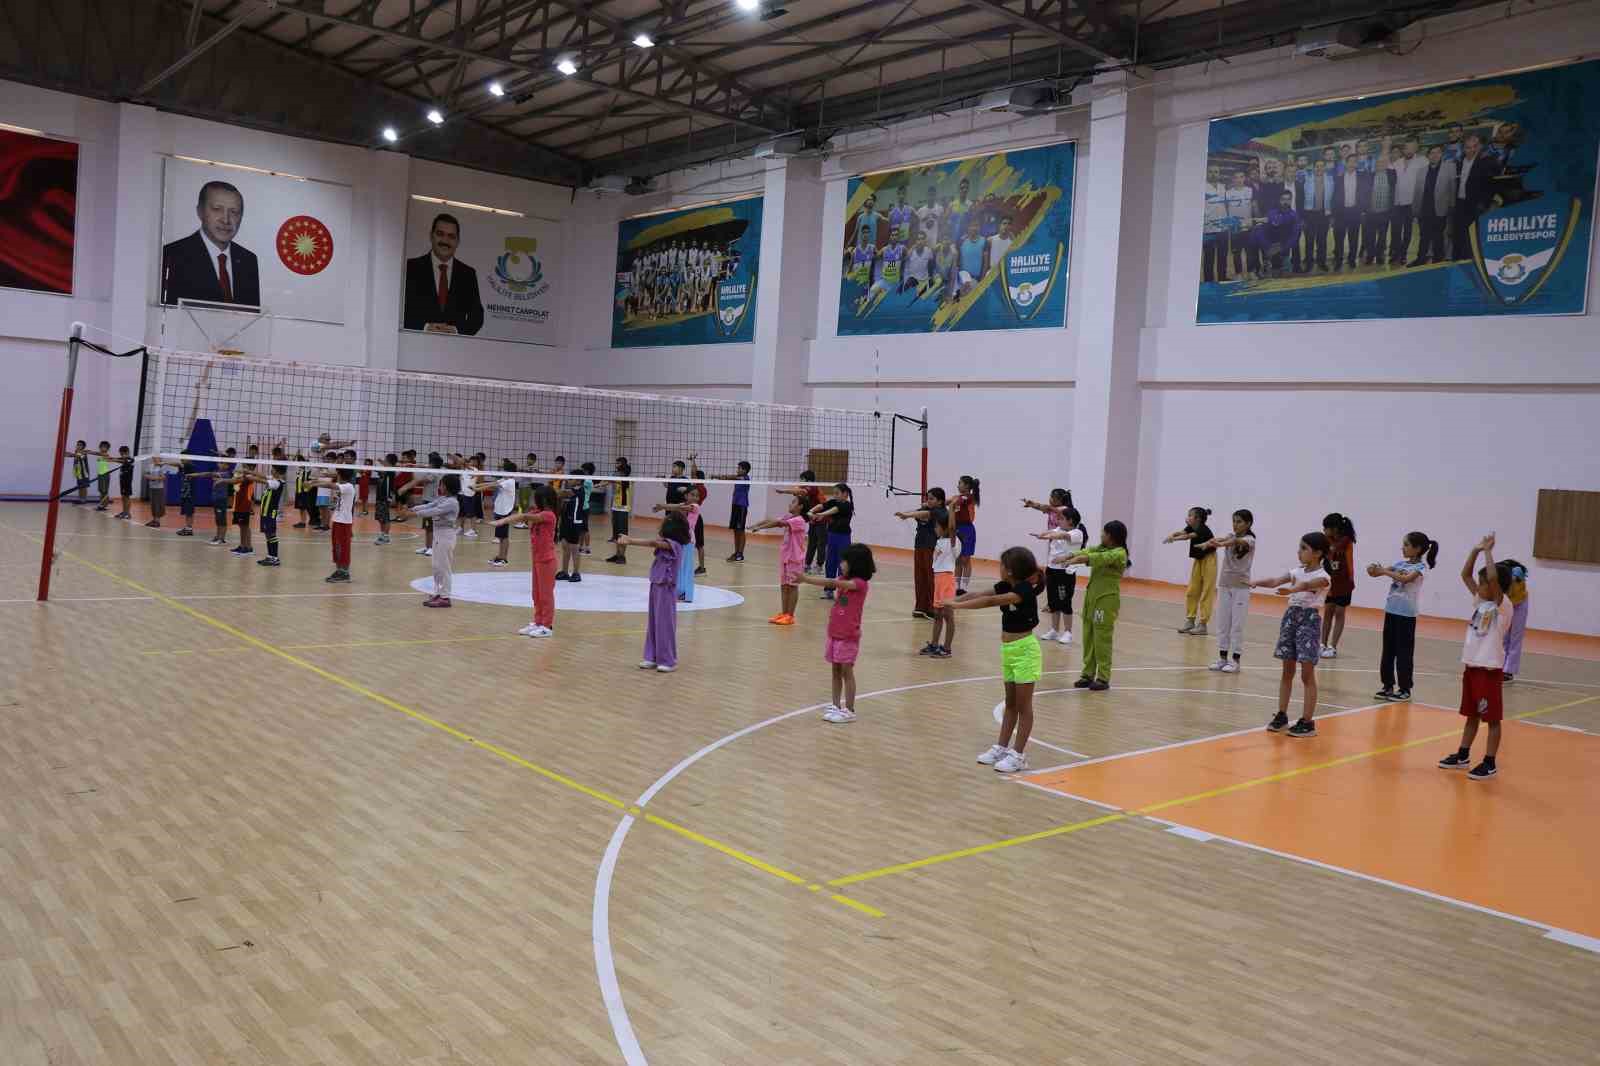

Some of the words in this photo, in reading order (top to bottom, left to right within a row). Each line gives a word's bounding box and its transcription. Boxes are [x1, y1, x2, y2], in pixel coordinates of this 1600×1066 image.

[1487, 214, 1557, 232] HALILIYE
[1487, 230, 1557, 242] BELEDIYESPOR
[1010, 254, 1050, 268] HALILIYE
